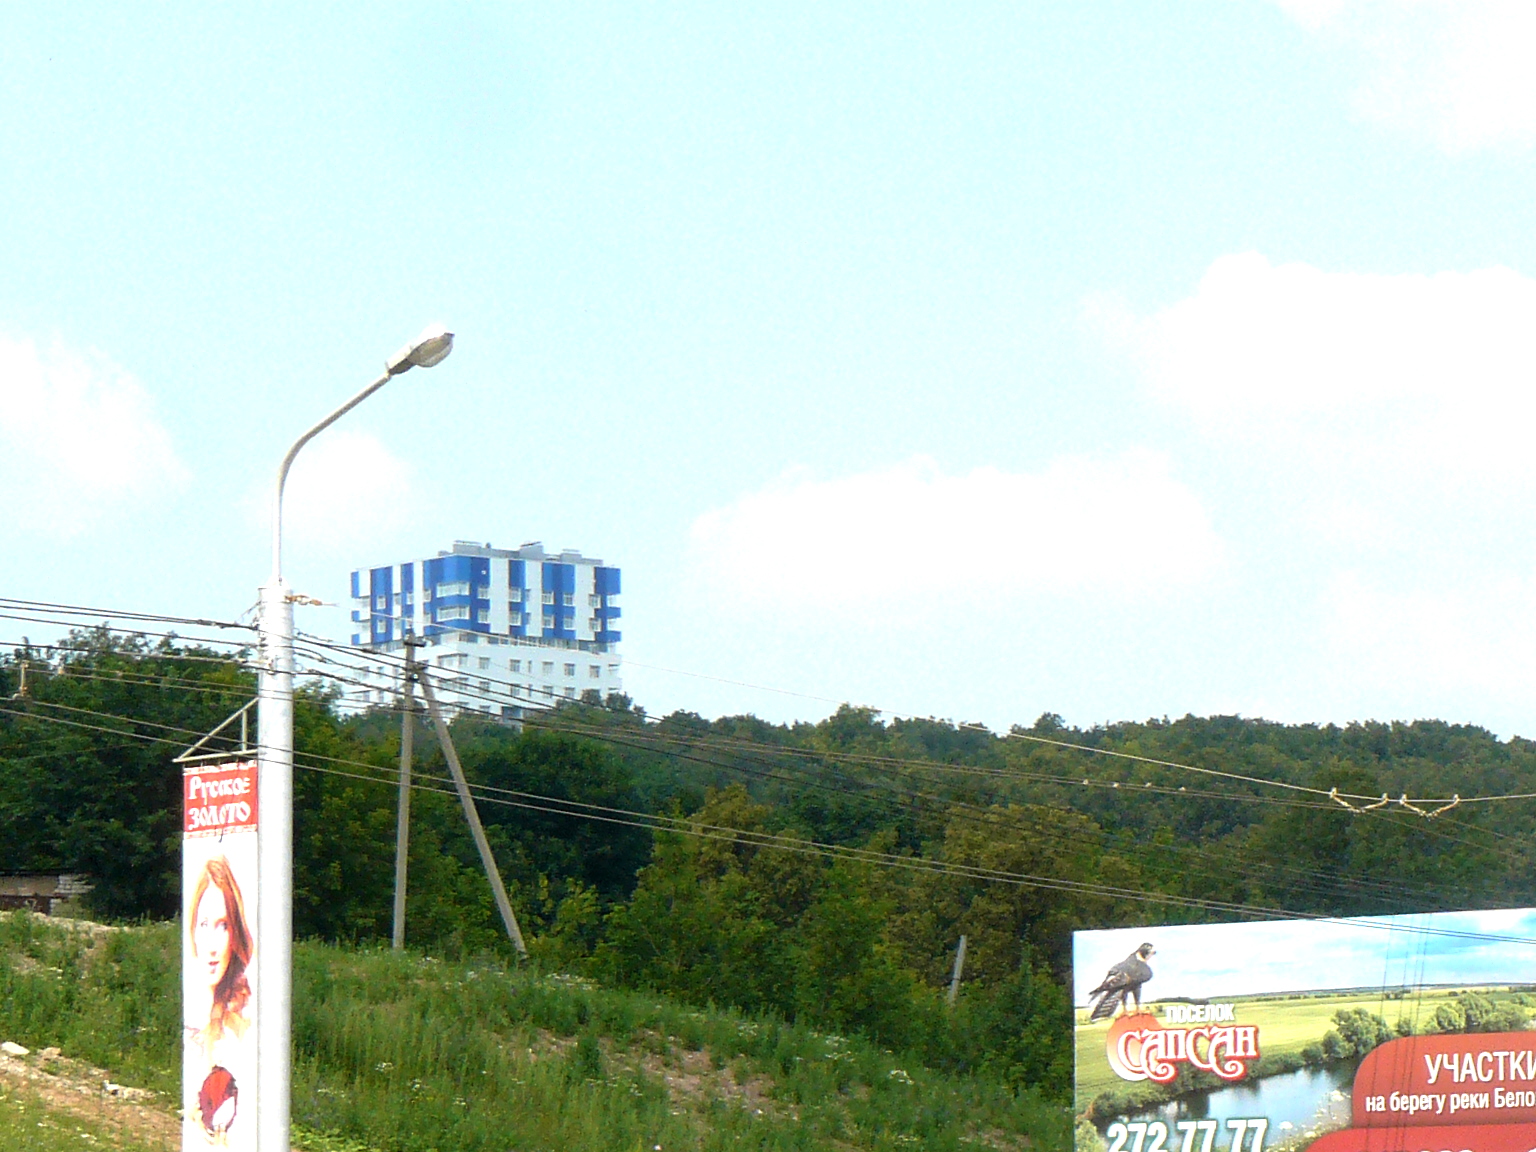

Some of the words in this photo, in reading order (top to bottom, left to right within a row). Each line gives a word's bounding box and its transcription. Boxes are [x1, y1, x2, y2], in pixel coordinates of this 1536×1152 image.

[1166, 1003, 1236, 1023] ПОСЕЛОК
[1365, 1095, 1386, 1112] на
[1389, 1091, 1446, 1115] берегу
[1450, 1092, 1489, 1113] реки
